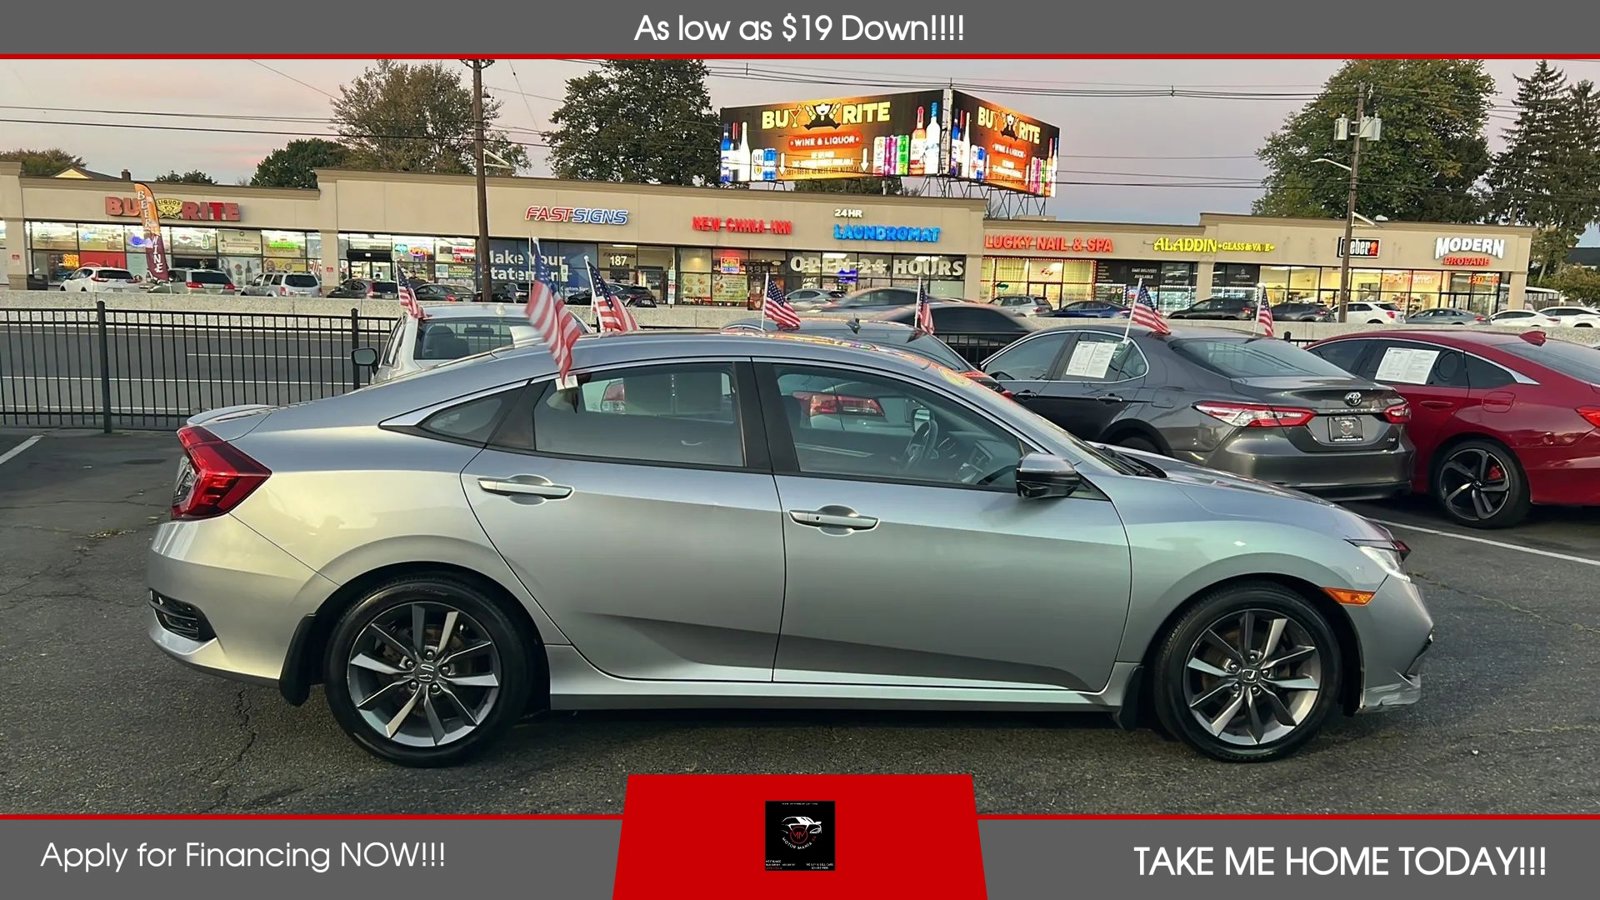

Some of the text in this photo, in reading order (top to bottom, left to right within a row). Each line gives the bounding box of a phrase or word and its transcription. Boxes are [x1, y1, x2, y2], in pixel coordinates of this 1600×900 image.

[842, 101, 891, 125] RITE
[794, 138, 815, 147] WINE
[824, 136, 855, 146] LIQUOR
[1018, 121, 1041, 145] RITE
[105, 196, 241, 221] BU RITE
[525, 205, 629, 225] FASTSIGNS
[137, 190, 164, 273] BEER WINE
[692, 216, 792, 235] NEW CHINA INN
[833, 223, 941, 243] LAUNDROMAT
[985, 234, 1113, 252] LUCKY NAIL & SPA
[1153, 237, 1217, 253] ALADDIN
[1252, 243, 1271, 252] VAE
[1342, 239, 1371, 255] eber
[1435, 237, 1505, 260] MODERN
[610, 255, 627, 267] 187
[790, 255, 964, 277] OPEN 24 HOURS
